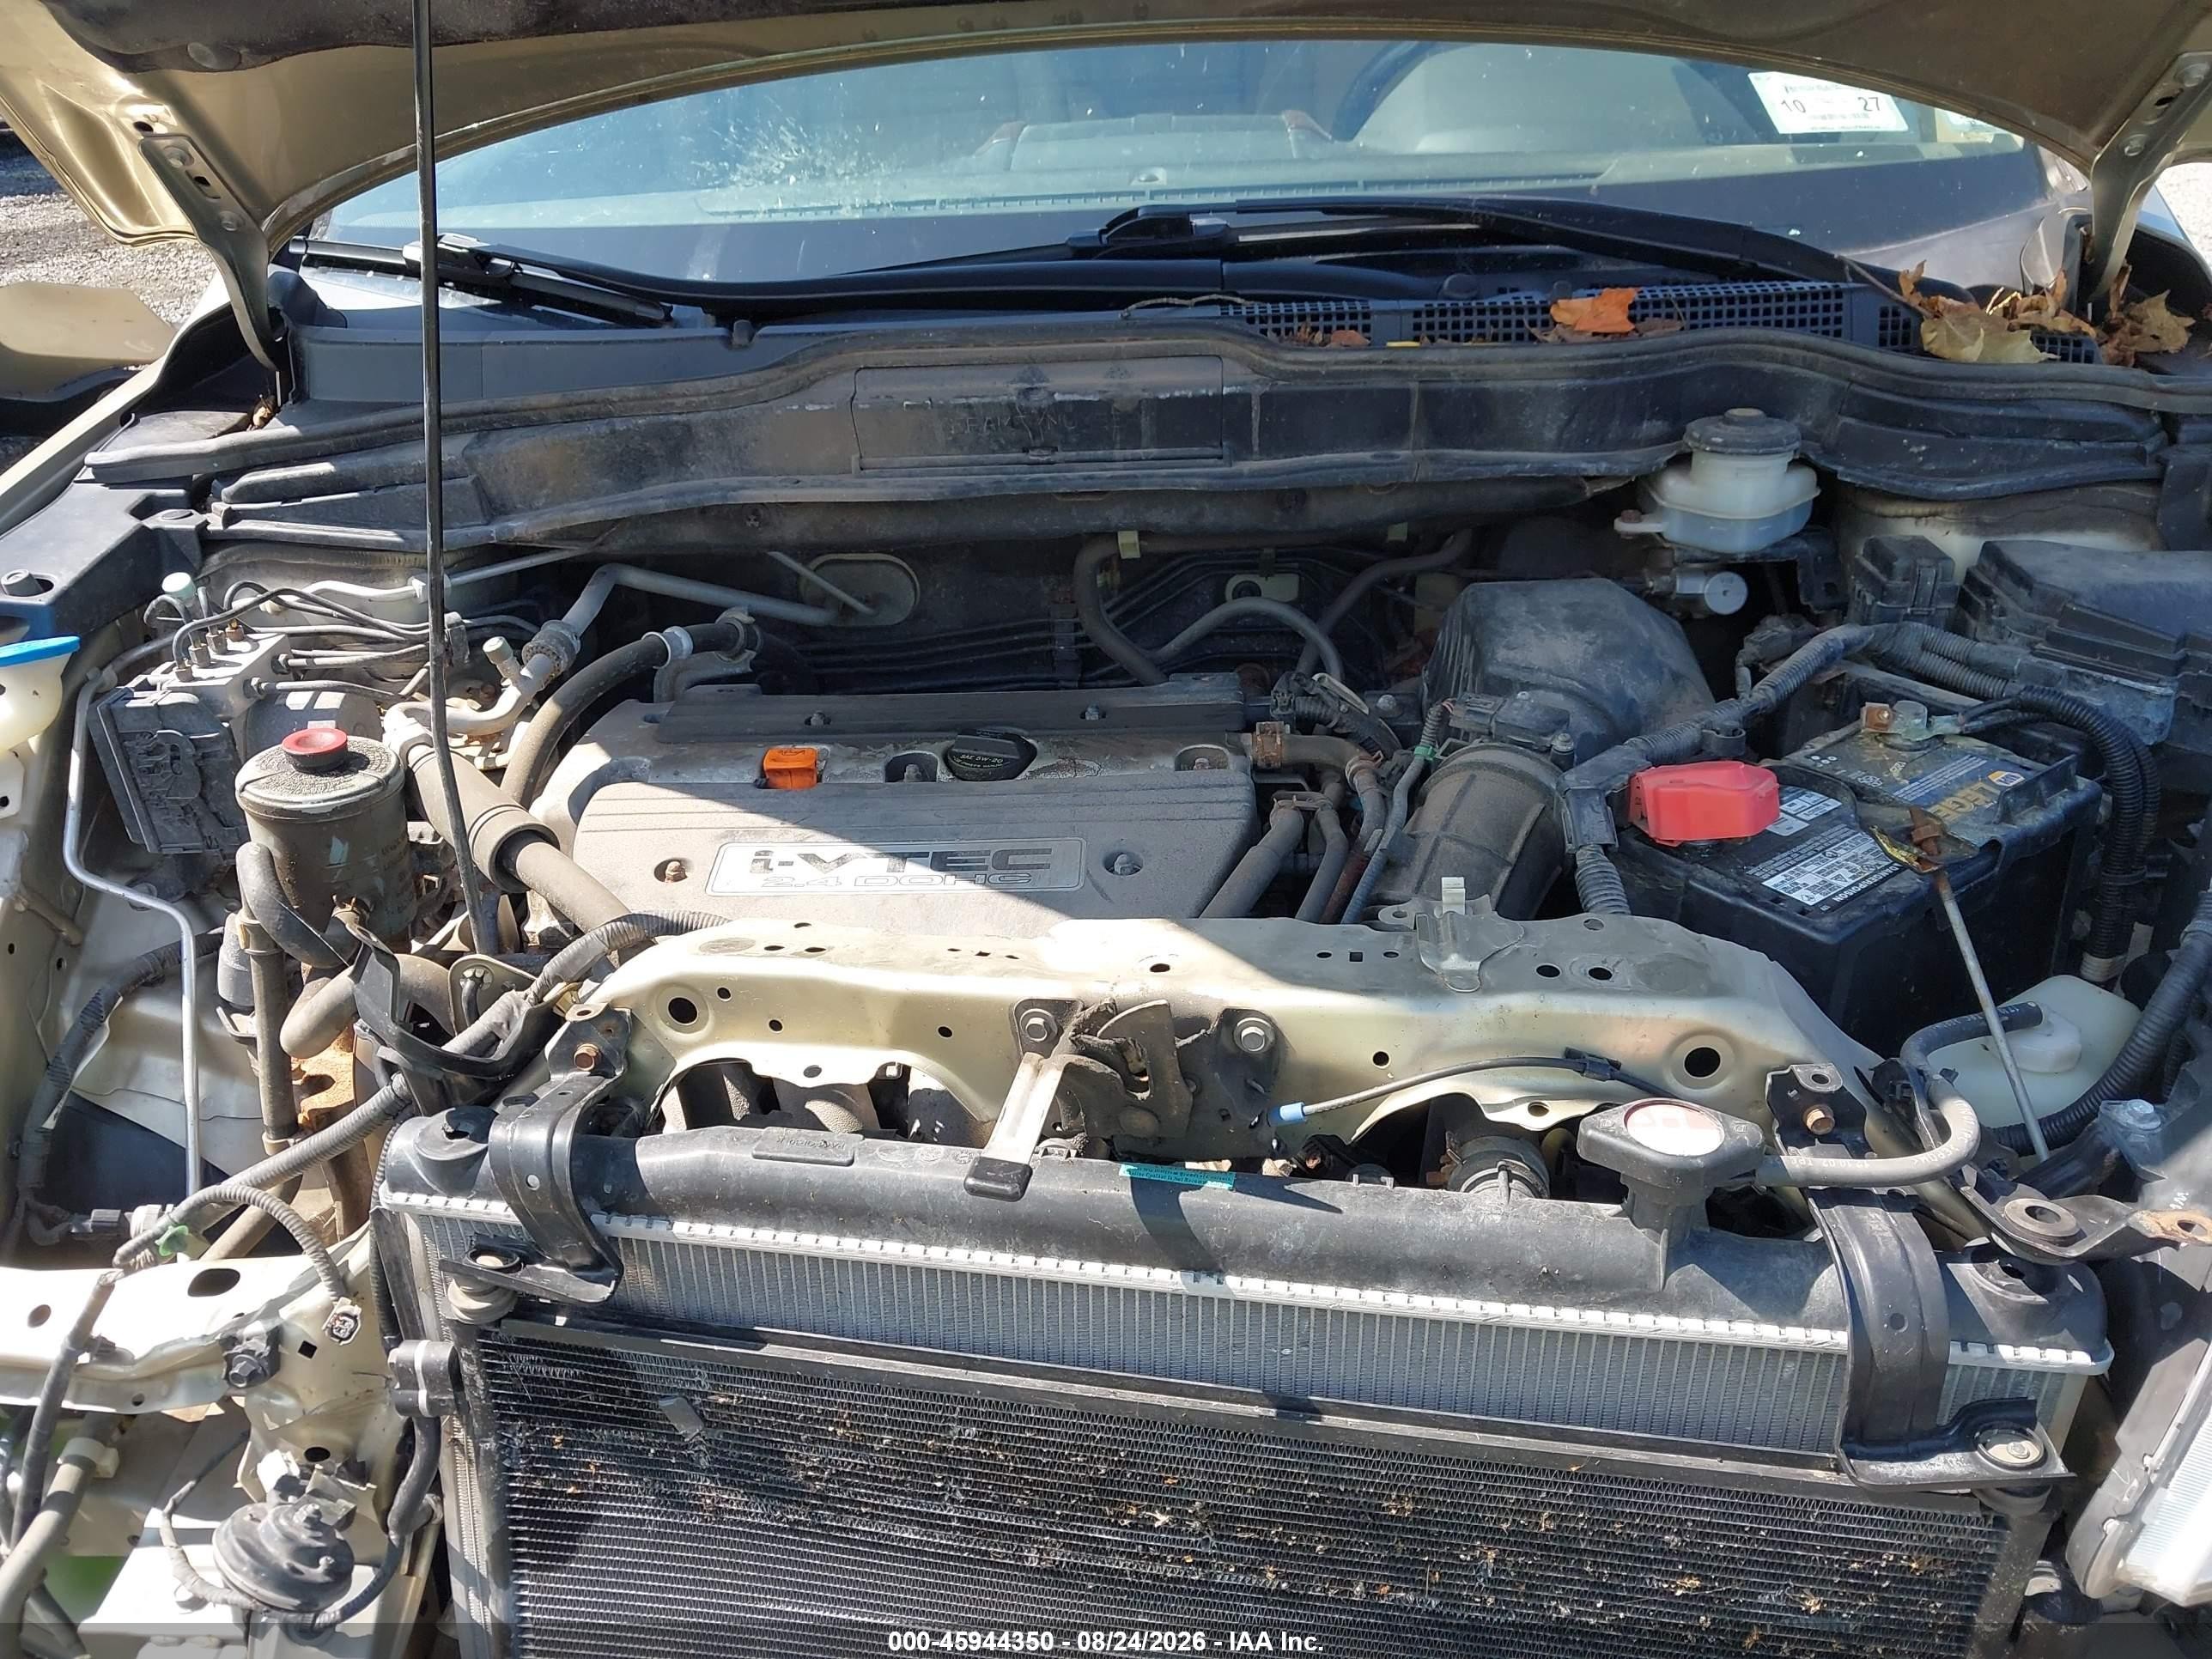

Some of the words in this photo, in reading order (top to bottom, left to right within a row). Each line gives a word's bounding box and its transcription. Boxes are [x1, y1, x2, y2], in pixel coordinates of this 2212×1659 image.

[1780, 99, 1807, 113] 10
[1857, 95, 1881, 112] 27
[750, 848, 1053, 874] i-VTEC
[760, 874, 842, 888] 2.4
[854, 872, 1032, 887] DOHC
